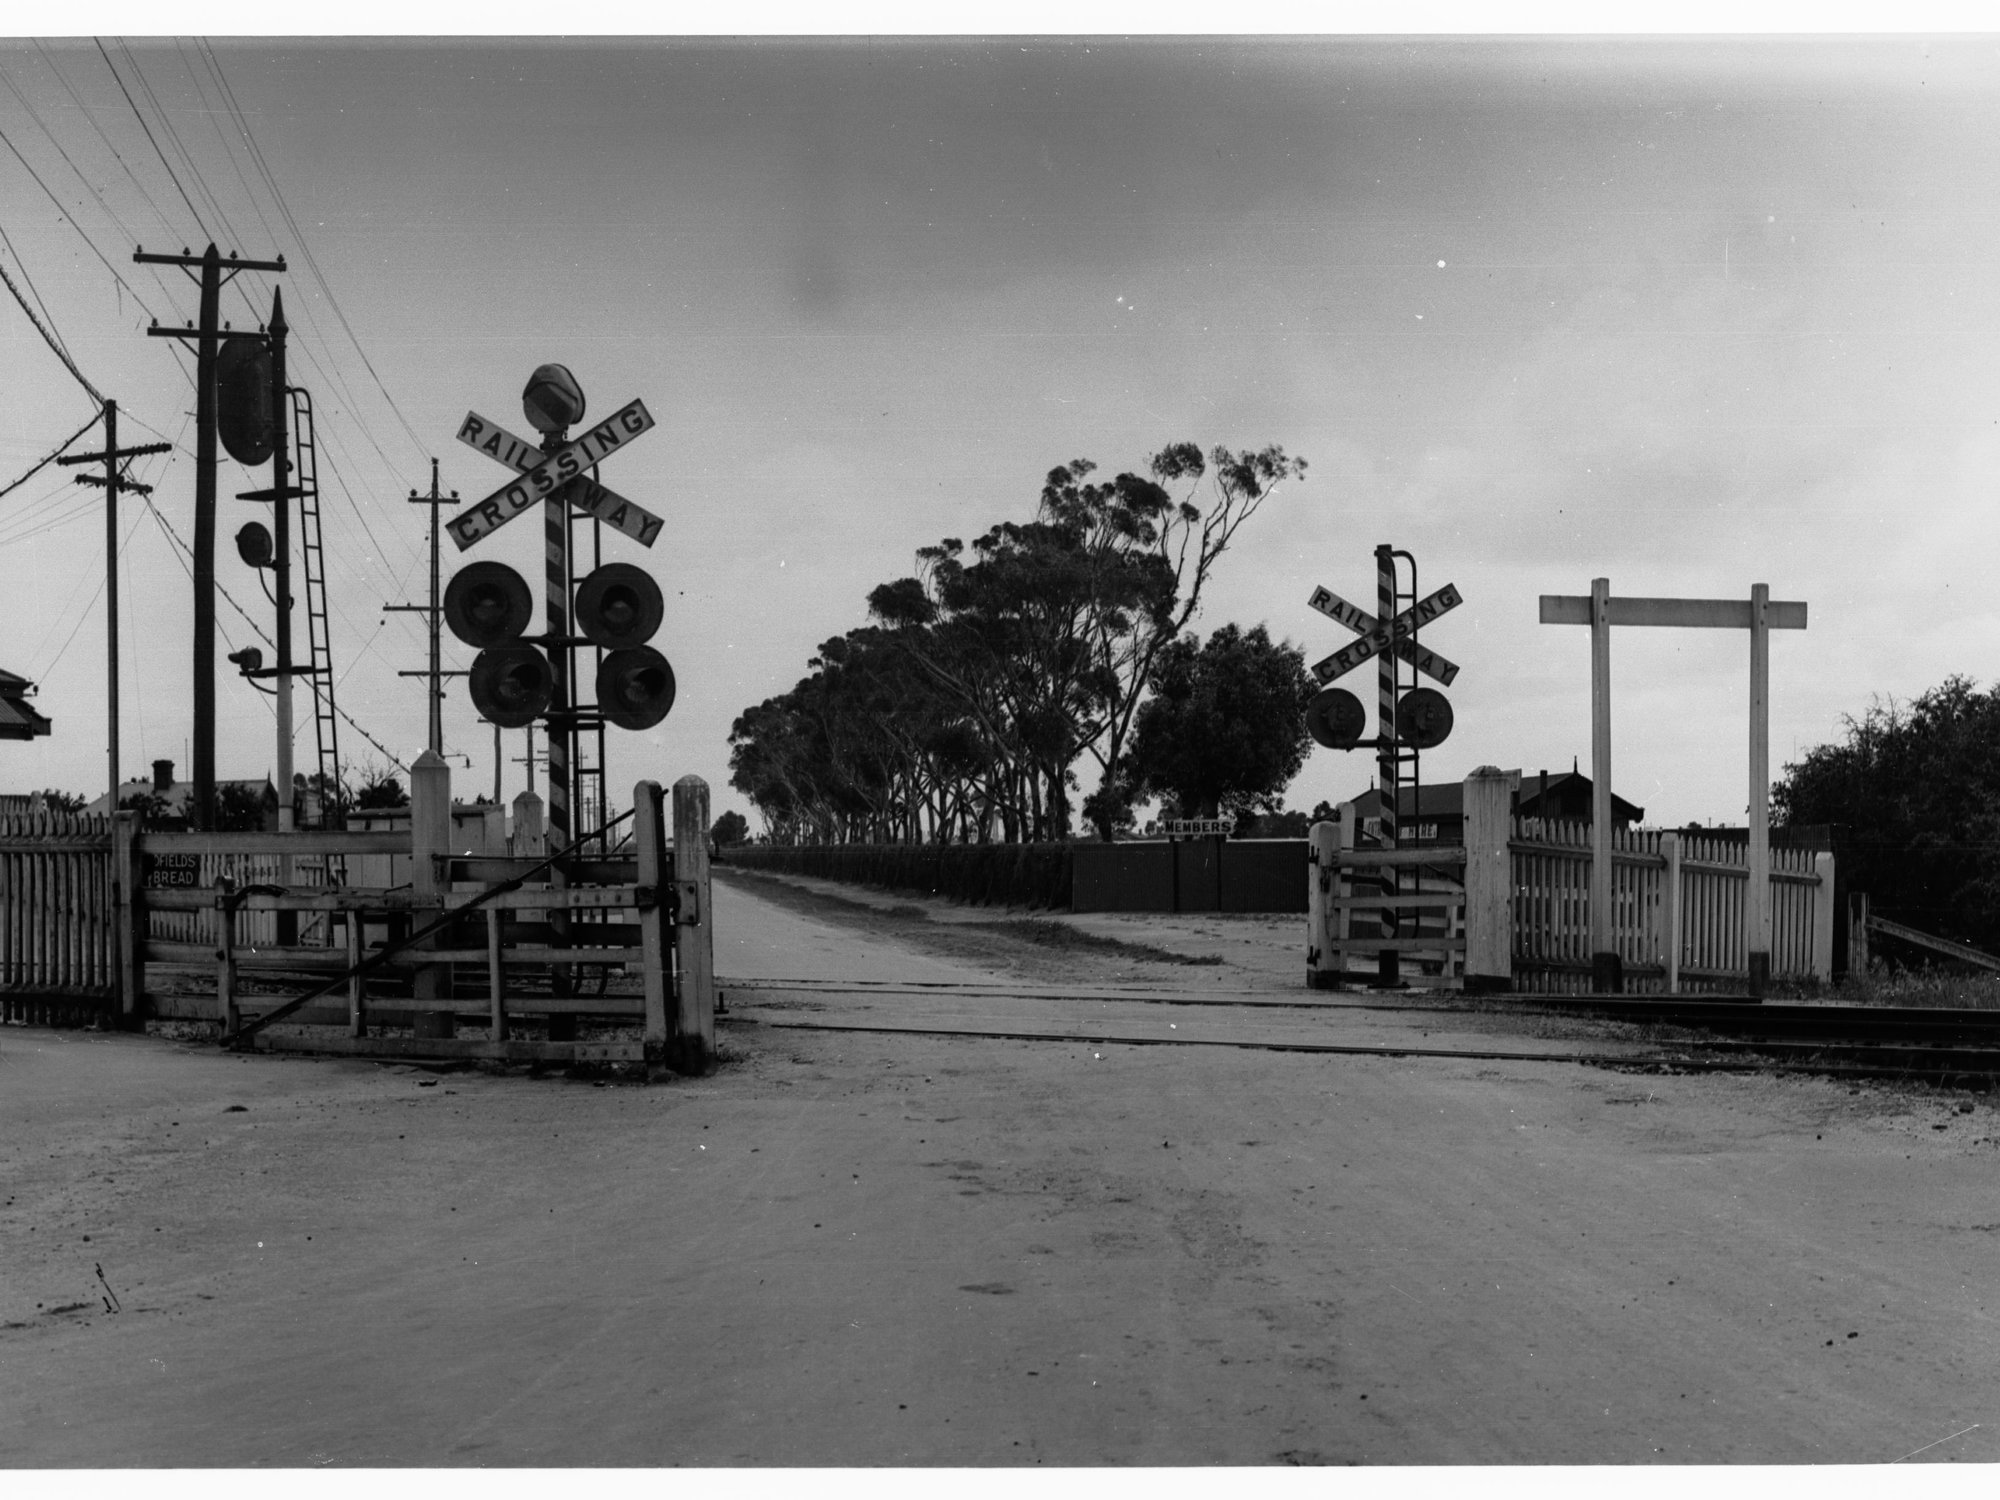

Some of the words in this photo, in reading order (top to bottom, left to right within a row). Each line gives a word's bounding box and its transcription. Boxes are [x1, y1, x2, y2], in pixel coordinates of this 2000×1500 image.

[456, 409, 644, 541] CROSSING
[1319, 590, 1455, 679] CROSSING
[1165, 821, 1231, 833] MEMBERS
[153, 871, 194, 885] BREAD
